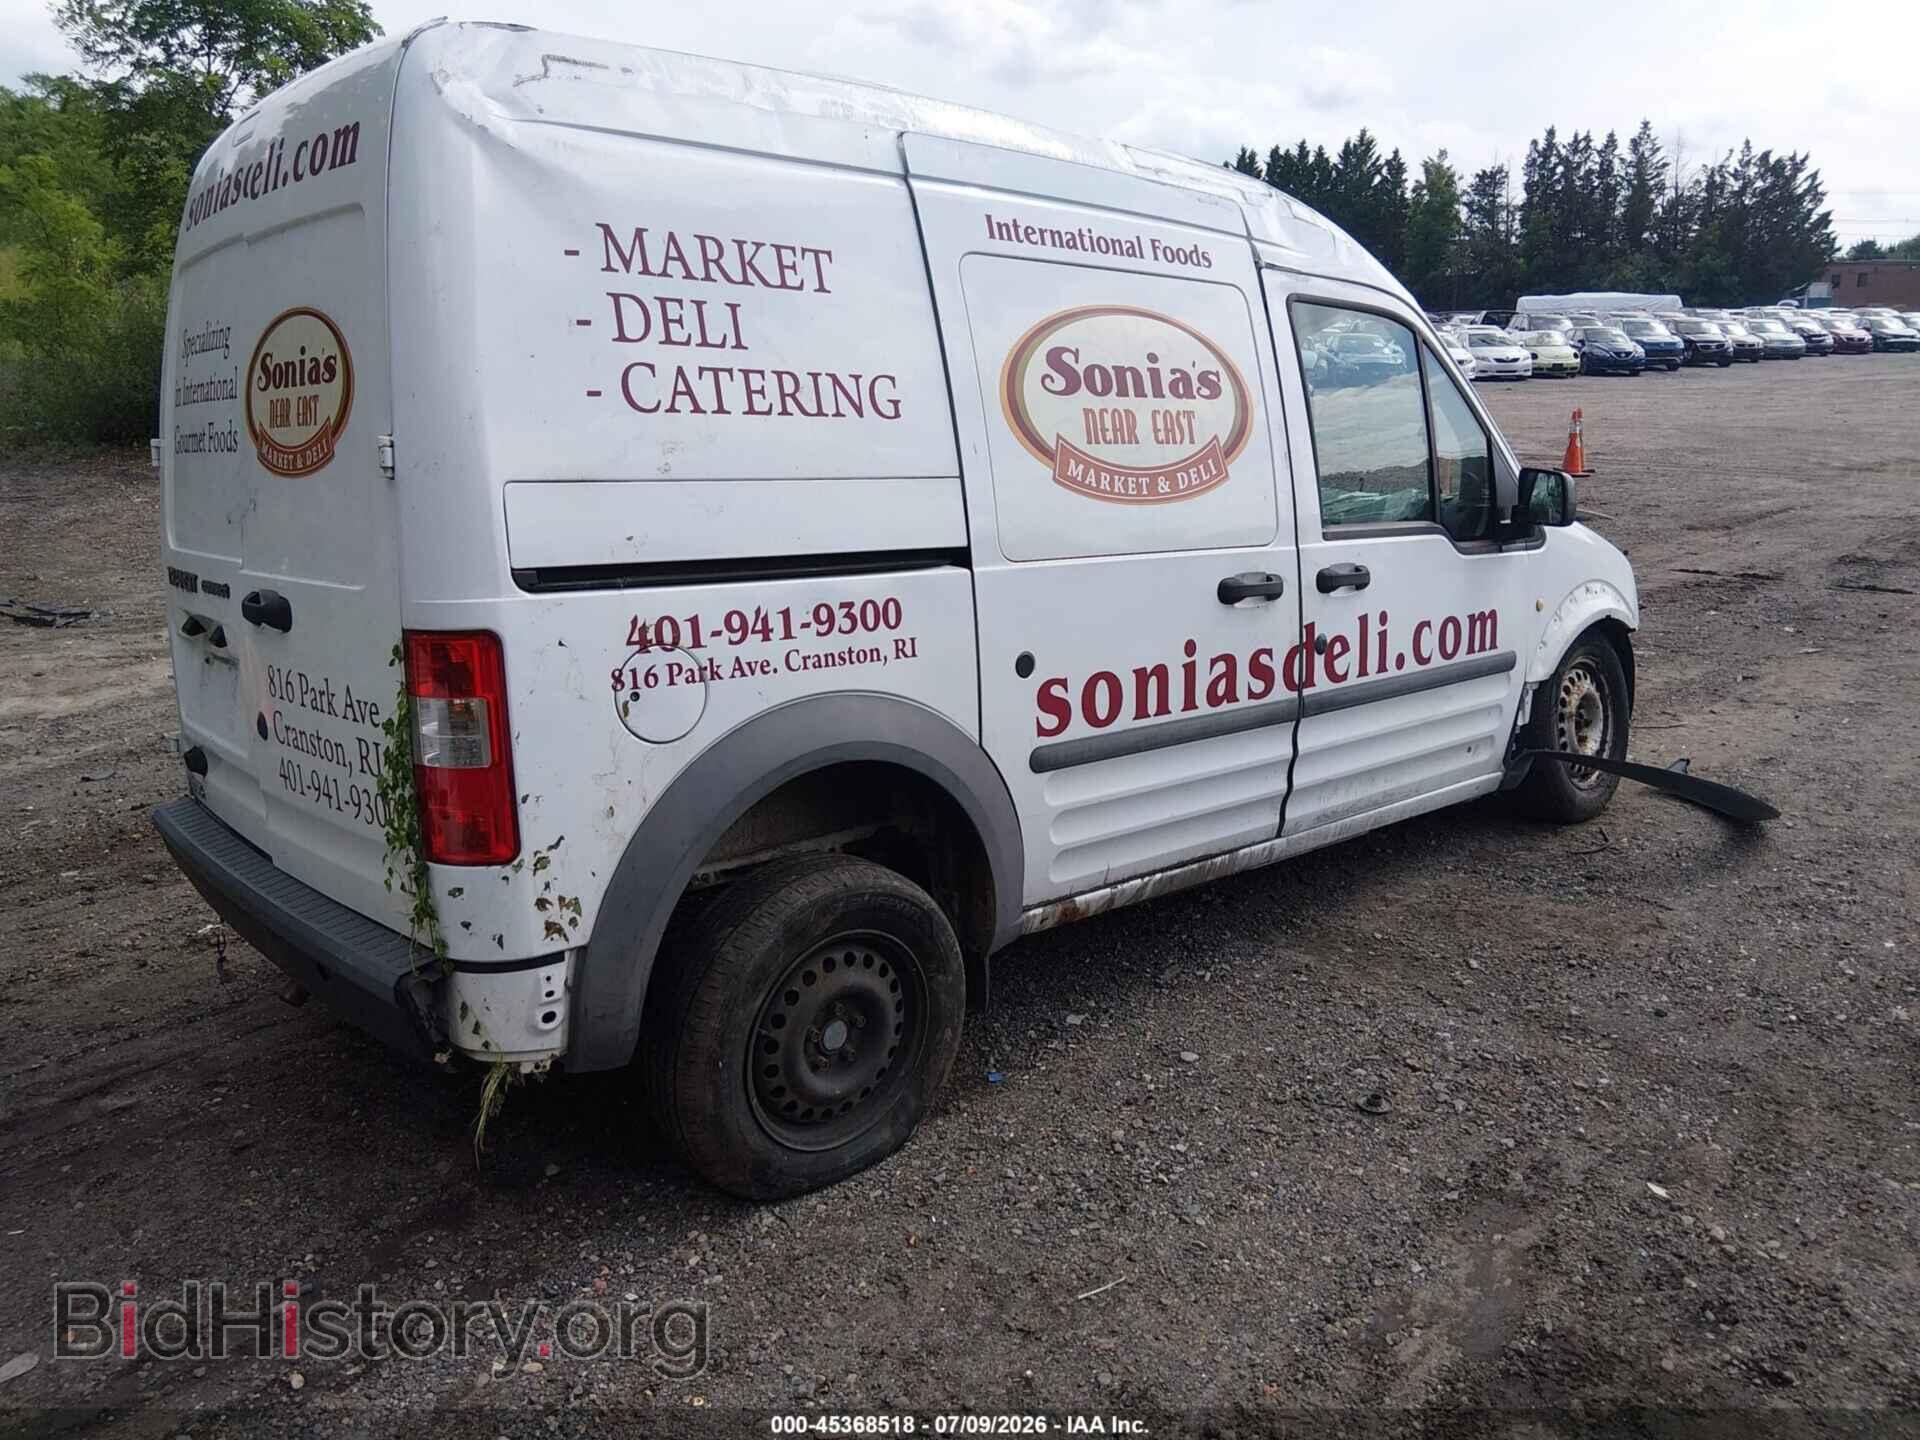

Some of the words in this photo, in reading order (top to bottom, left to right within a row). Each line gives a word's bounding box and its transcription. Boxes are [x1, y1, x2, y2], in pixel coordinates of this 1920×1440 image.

[595, 222, 833, 294] MARKET
[985, 214, 1145, 259] International
[1149, 237, 1212, 269] Foods
[182, 320, 231, 367] Specializing
[606, 292, 749, 350] DELI
[183, 365, 238, 405] International
[257, 345, 338, 392] Sonia's
[620, 362, 902, 420] CATERING
[1040, 346, 1222, 400] Sonia's
[174, 425, 206, 454] Gourmet
[207, 419, 238, 453] Foods
[269, 397, 292, 429] NEAR
[297, 394, 320, 427] EAST
[1082, 407, 1140, 445] NEAR
[1151, 409, 1197, 445] EAST
[262, 440, 294, 470] MARKET
[306, 438, 328, 466] DELI
[1066, 458, 1150, 495] MARKET
[1158, 476, 1170, 493] &
[1176, 458, 1219, 490] DELI
[625, 597, 903, 655] 401-941-9300
[611, 665, 659, 692] 816
[666, 661, 724, 687] Park
[728, 655, 778, 679] Ave.
[784, 643, 888, 672] Cranston,
[893, 637, 919, 660] RI
[1035, 607, 1499, 738] soniasdeli.com
[267, 665, 295, 704] 816
[298, 673, 338, 719] Park
[273, 711, 353, 778] Cranston,
[356, 737, 382, 778] RI
[279, 757, 395, 829] 401-941-930
